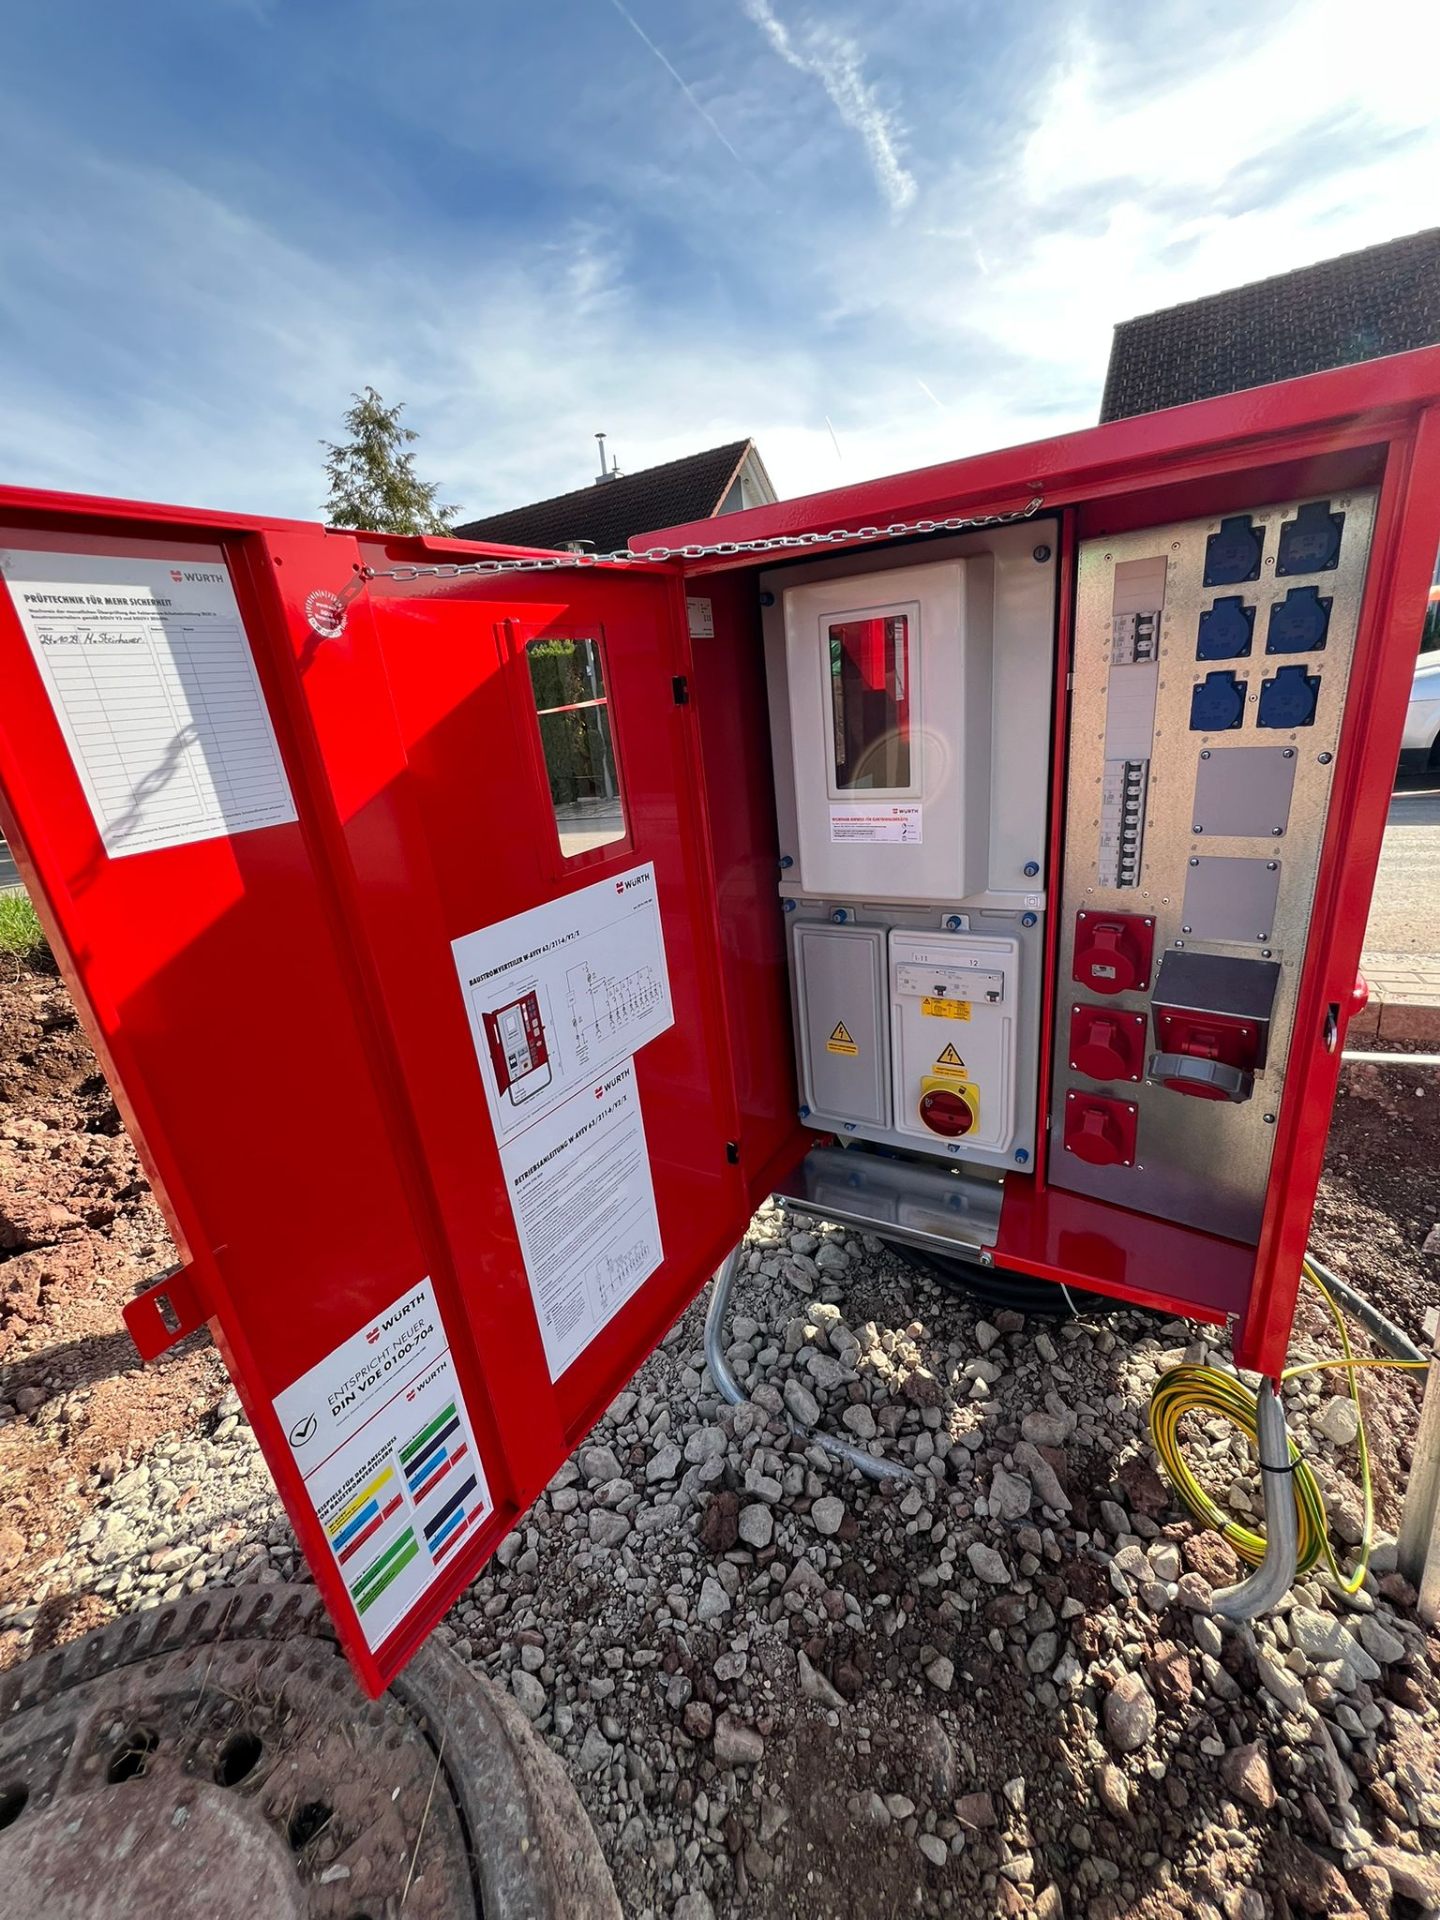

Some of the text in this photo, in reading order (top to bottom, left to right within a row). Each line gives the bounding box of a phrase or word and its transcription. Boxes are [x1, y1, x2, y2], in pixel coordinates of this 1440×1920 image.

[184, 572, 224, 583] WÜRTH
[23, 592, 172, 607] PRÜFTECHNIK FÜR MEHR SICHERHEIT
[624, 872, 650, 890] WÜRTH
[468, 956, 523, 987] BAUSTROMVERTEILER
[604, 1068, 631, 1092] WÜRTH
[514, 1139, 569, 1186] BETRIEBSANLEITUNG
[381, 1292, 425, 1332] WÜRTH
[327, 1318, 426, 1406] ENTSPRICHT NEUER
[331, 1323, 434, 1417] DIN VDE 0100-704
[416, 1360, 448, 1393] WÜRTH
[330, 1446, 394, 1511] BAUSTROMVERTEILERN
[342, 1472, 354, 1491] FÜR
[354, 1465, 367, 1479] DEN
